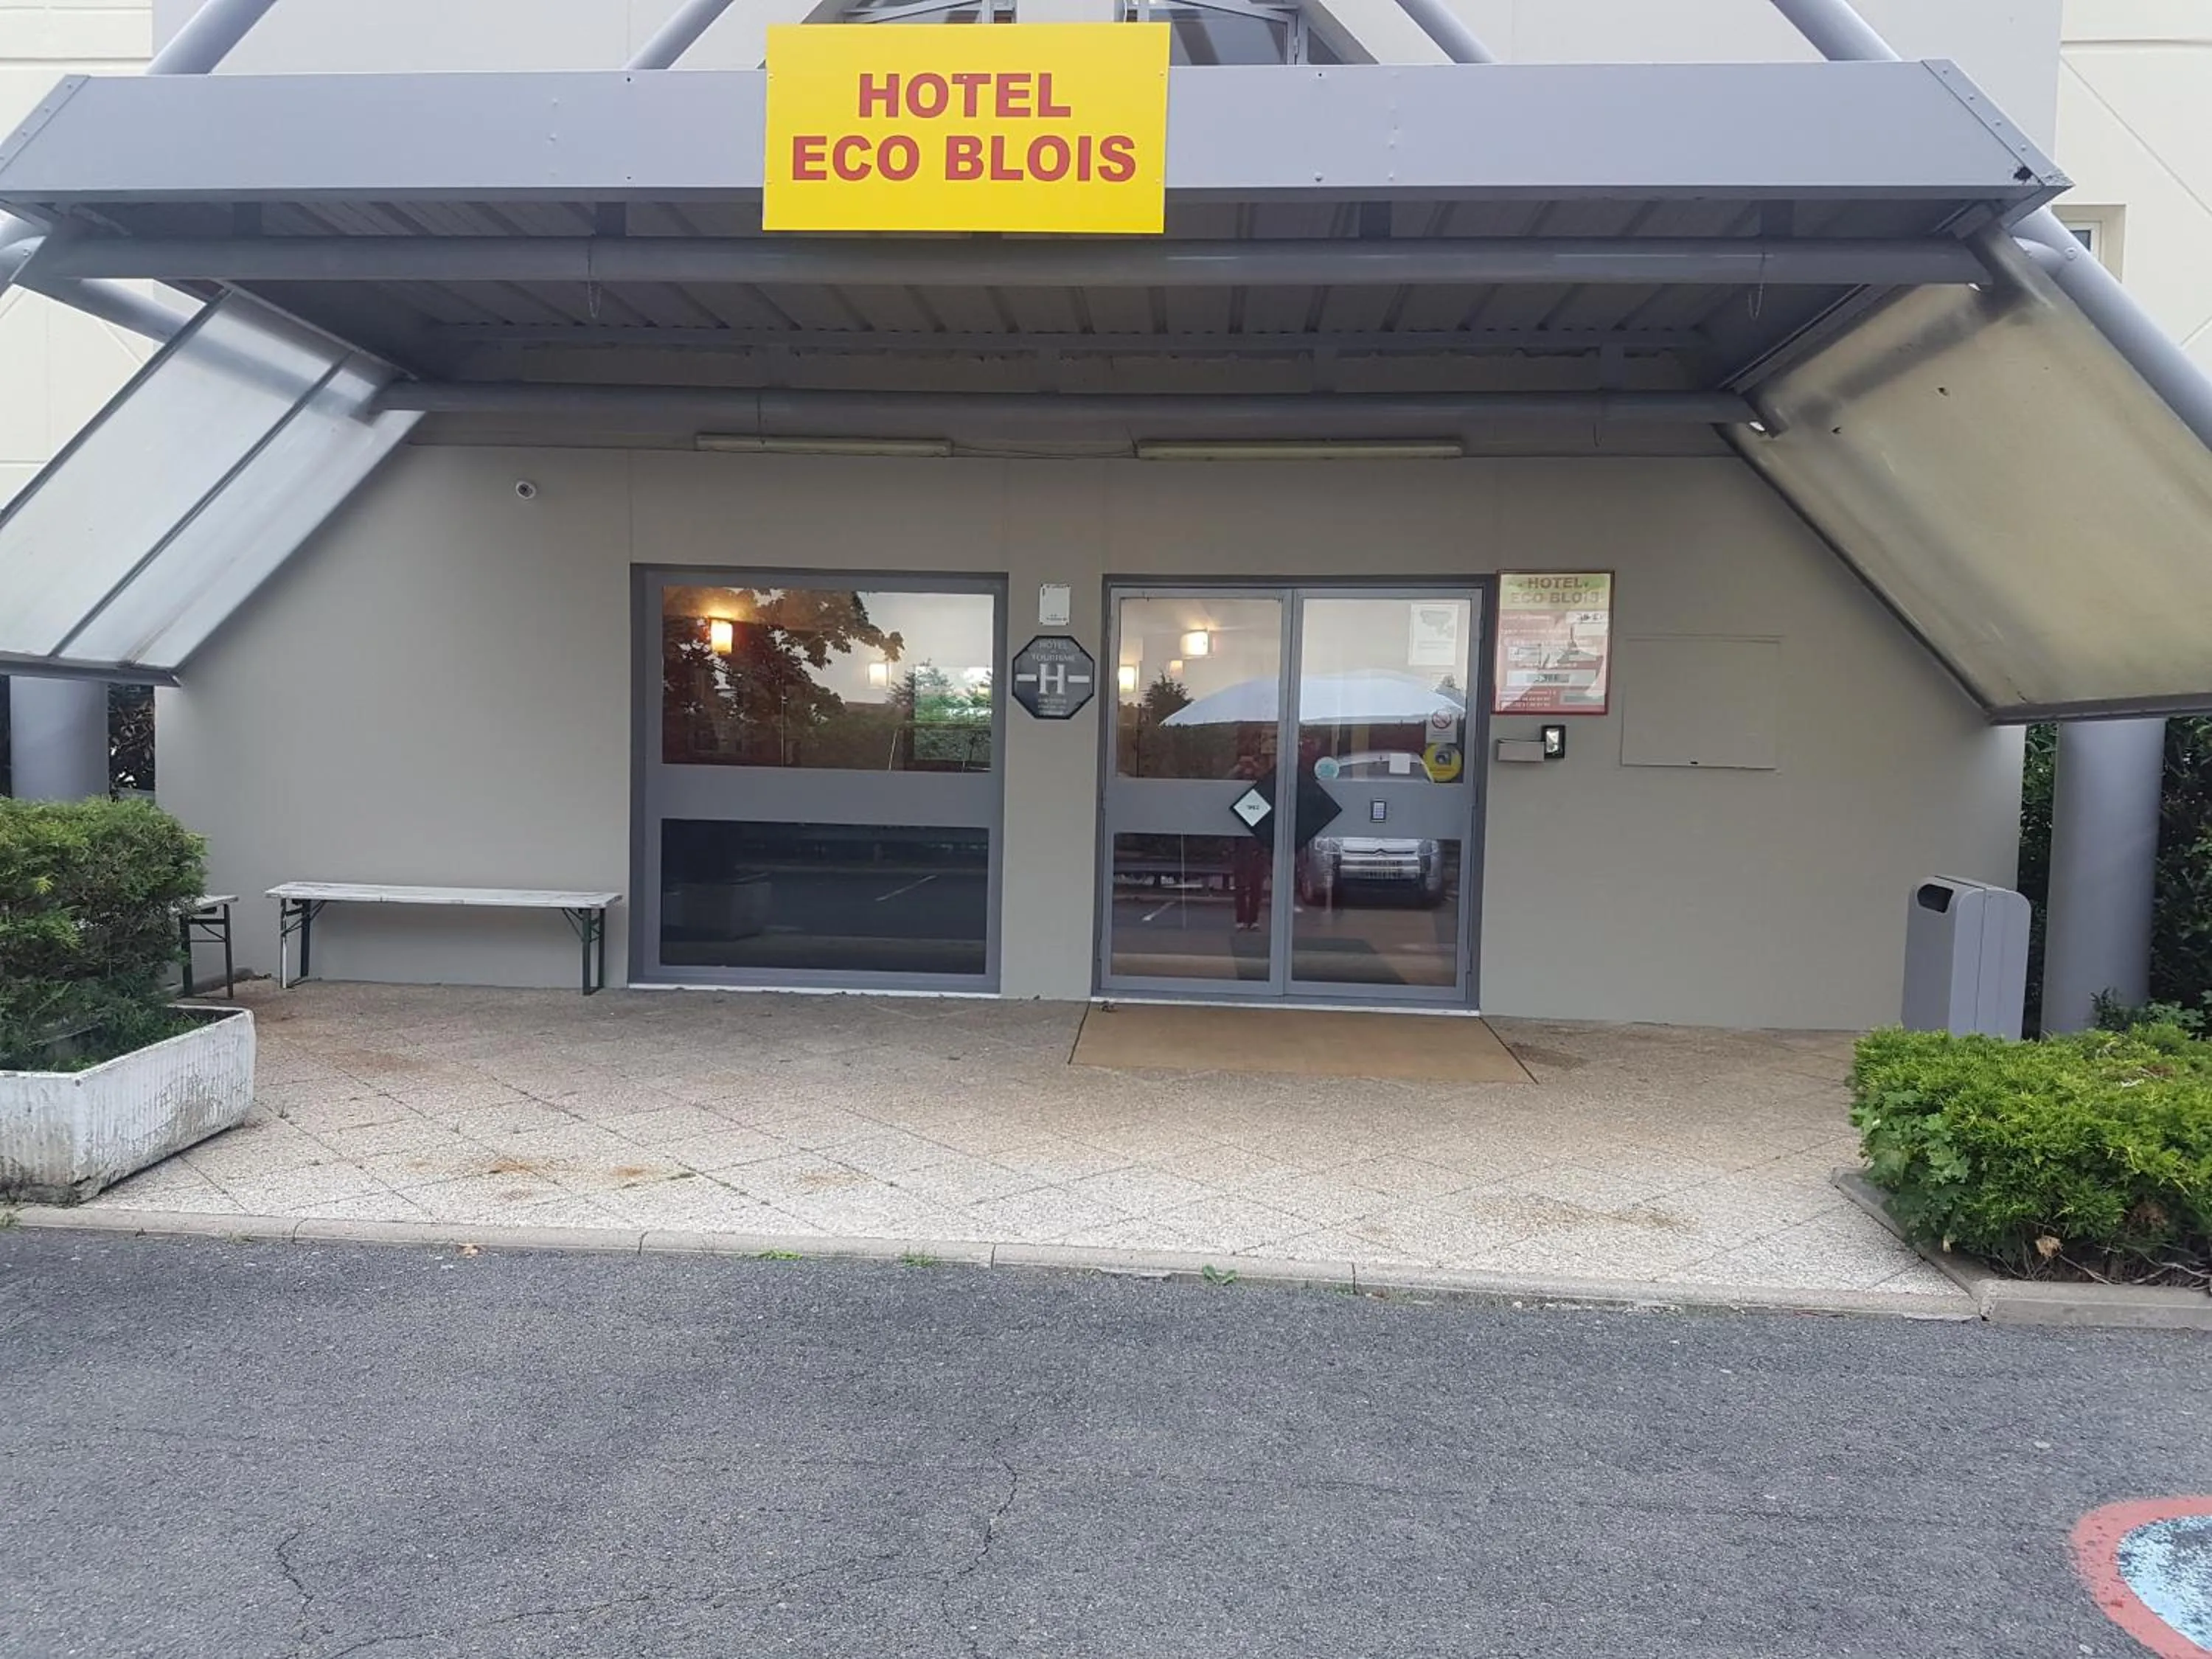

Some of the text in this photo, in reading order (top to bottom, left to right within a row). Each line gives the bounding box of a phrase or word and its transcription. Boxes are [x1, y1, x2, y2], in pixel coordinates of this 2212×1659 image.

[858, 72, 1071, 118] HOTEL
[791, 135, 1136, 182] ECO BLOIS
[1511, 592, 1545, 603] ECO
[1528, 577, 1583, 588] HOTEL
[1039, 664, 1066, 694] H
